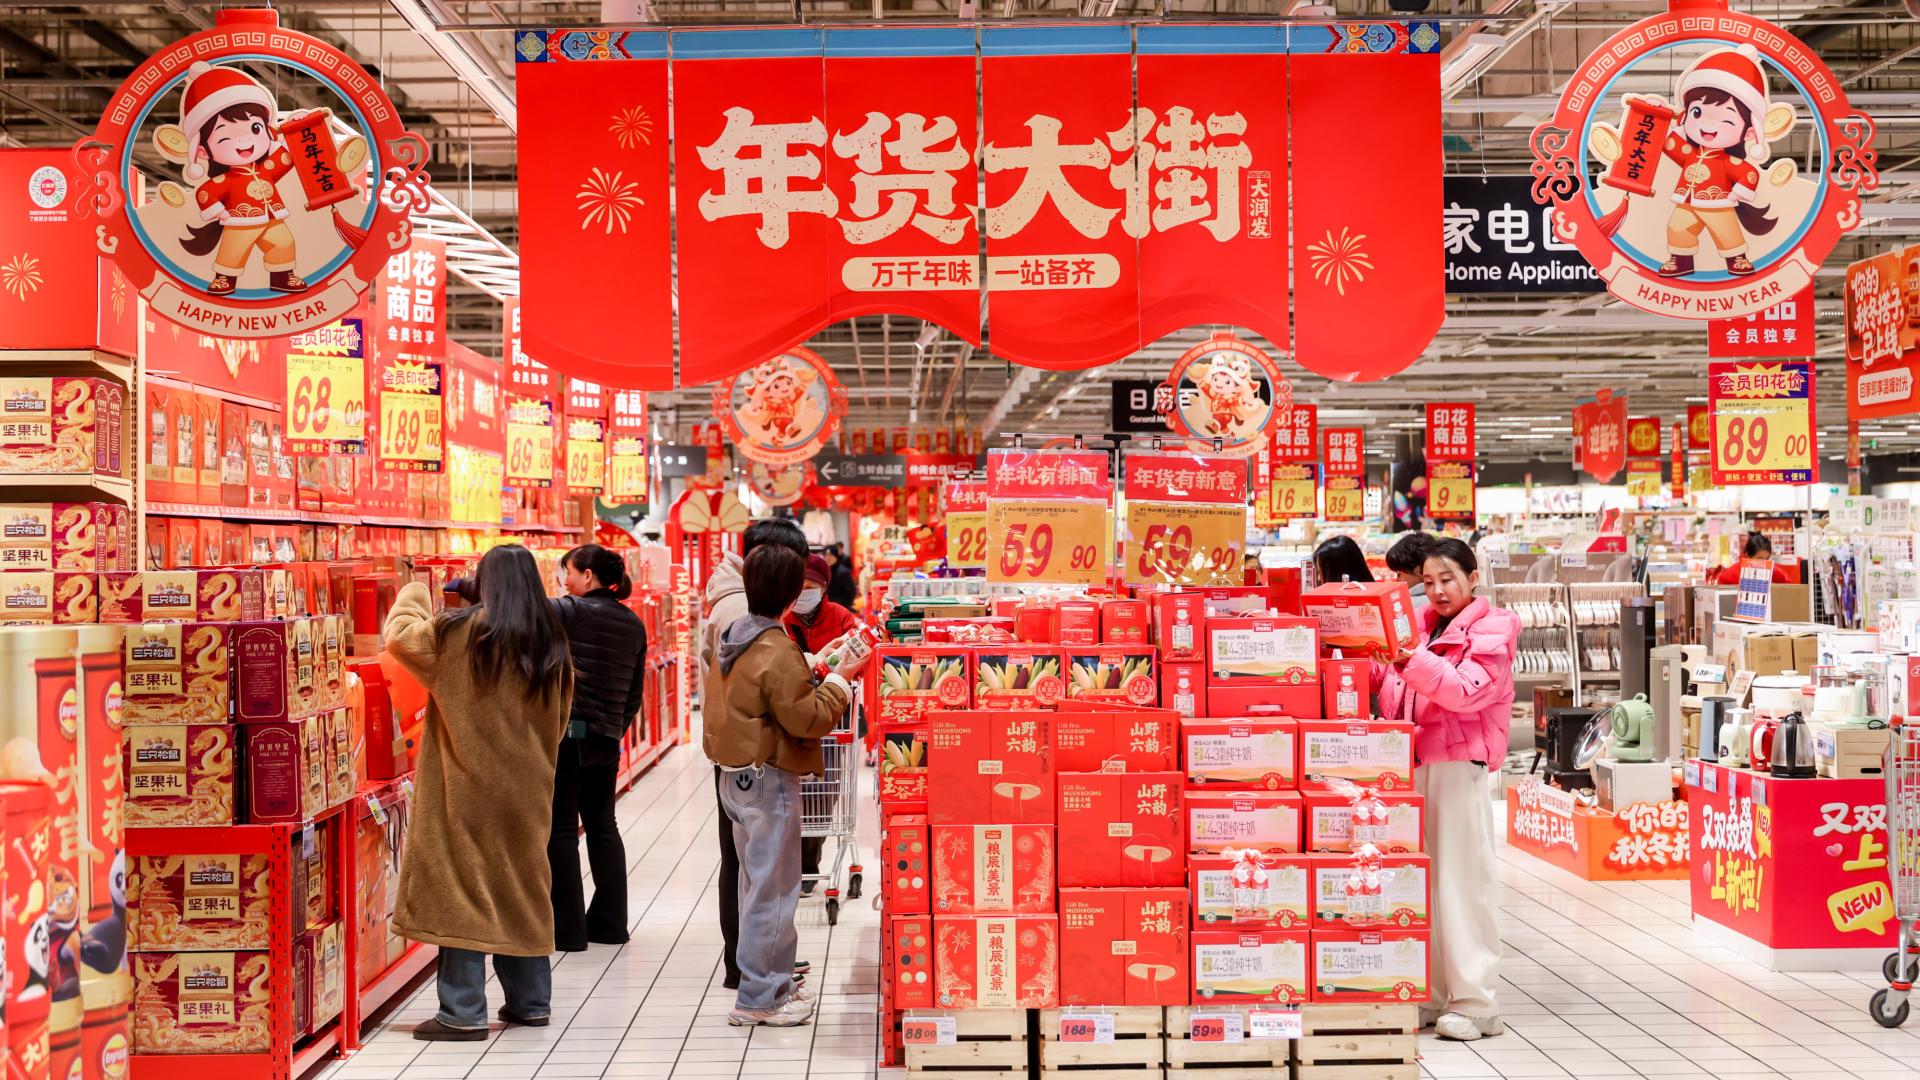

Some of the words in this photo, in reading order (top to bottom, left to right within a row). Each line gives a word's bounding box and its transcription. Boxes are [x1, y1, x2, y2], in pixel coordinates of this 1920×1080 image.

[1628, 114, 1655, 181] 马年大吉
[300, 127, 335, 194] 马年大吉
[696, 105, 1252, 249] 年货大街
[1249, 178, 1271, 238] 大润发
[386, 250, 437, 287] 印花
[871, 259, 973, 288] 万千年味
[995, 258, 1096, 286] 一站备齐
[1444, 261, 1502, 281] Home
[1851, 265, 1880, 302] 你的
[385, 285, 436, 324] 商品
[1636, 283, 1690, 312] HAPPY
[1695, 295, 1734, 312] NEW
[1738, 280, 1783, 309] YEAR
[177, 300, 234, 330] HAPPY
[238, 315, 278, 331] NEW
[281, 300, 328, 327] YEAR
[386, 326, 435, 345] 会员独享
[1726, 328, 1797, 344] 会员独享
[1861, 321, 1903, 370] 已上线
[1718, 373, 1805, 393] 会员印花价
[6, 400, 45, 411] 三只松鼠
[292, 375, 332, 434] 68
[1433, 408, 1468, 427] 印花
[2, 424, 47, 437] 坚果礼
[384, 408, 422, 456] 189
[1275, 428, 1310, 446] 商品
[1329, 432, 1358, 448] 印花
[1433, 426, 1468, 446] 商品
[1723, 417, 1769, 466] 89
[1784, 434, 1808, 457] 00
[510, 437, 534, 474] 89
[996, 466, 1099, 487] 年礼有排面
[1133, 468, 1238, 491] 年货有新意
[1276, 487, 1295, 510] 16
[1437, 486, 1450, 508] 9
[6, 525, 45, 536] 三只松鼠
[2, 549, 47, 562] 坚果礼
[1001, 523, 1054, 578] 59
[1071, 544, 1097, 570] 90
[1138, 524, 1193, 579] 59
[7, 595, 47, 606] 三只松鼠
[149, 594, 190, 605] 三只松鼠
[676, 572, 689, 625] HAPPY
[133, 648, 174, 659] 三只松鼠
[130, 673, 177, 687] 坚果礼
[1007, 721, 1037, 737] 山野
[1130, 722, 1160, 737] 山野
[138, 749, 179, 760] 三只松鼠
[1006, 738, 1036, 753] 六韵
[1130, 738, 1159, 753] 六韵
[134, 774, 182, 788] 坚果礼
[1137, 784, 1168, 799] 山野
[1137, 800, 1167, 816] 六韵
[1618, 801, 1690, 833] 你的
[192, 873, 232, 883] 三只松鼠
[985, 841, 1001, 897] 粮辰美景
[188, 898, 235, 911] 坚果礼
[1141, 901, 1171, 917] 山野
[1836, 886, 1883, 924] NEW
[1140, 917, 1171, 934] 六韵
[989, 935, 1004, 991] 粮辰美景
[186, 977, 227, 987] 三只松鼠
[183, 1002, 230, 1015] 坚果礼
[905, 1028, 922, 1040] 88
[1064, 1024, 1087, 1036] 168
